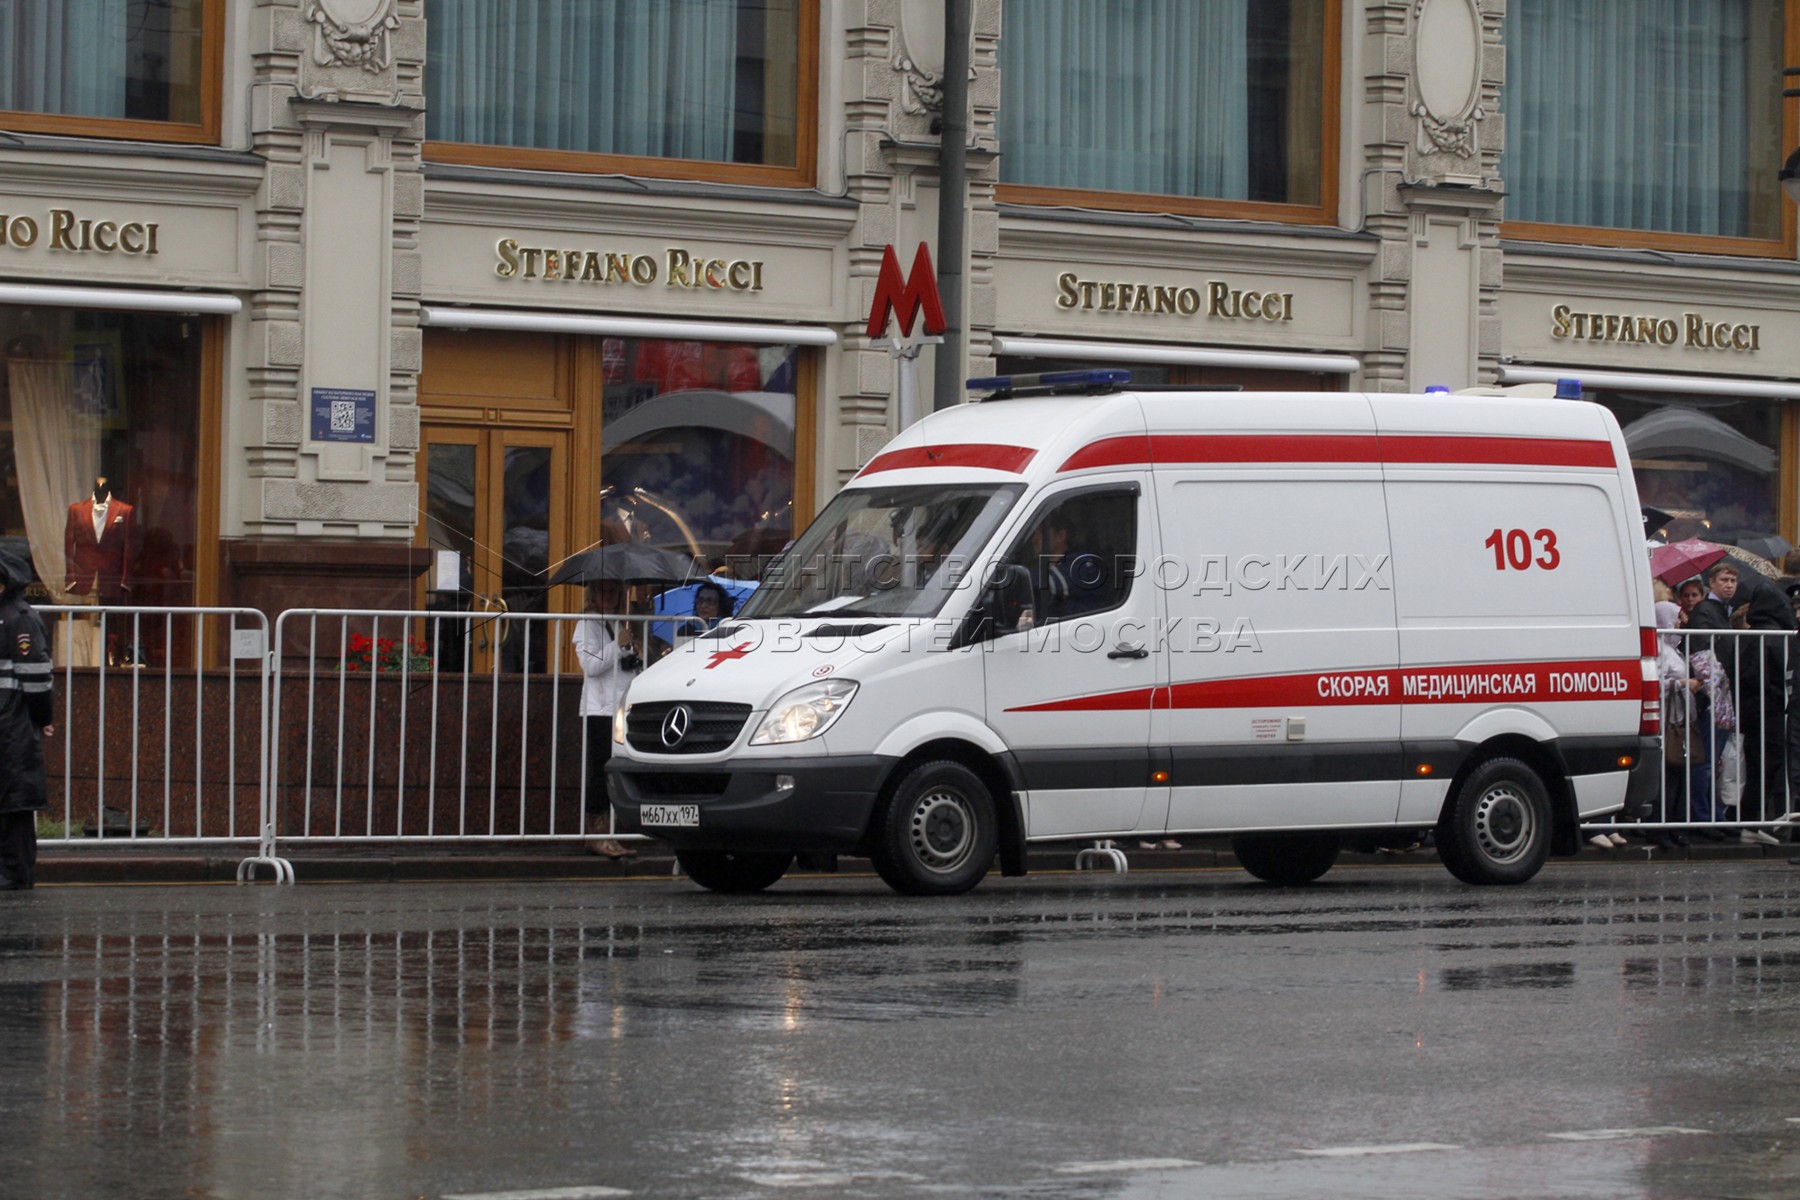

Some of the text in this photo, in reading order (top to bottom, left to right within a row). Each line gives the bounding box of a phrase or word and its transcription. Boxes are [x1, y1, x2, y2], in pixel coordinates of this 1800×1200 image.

[1484, 528, 1560, 571] 103
[1317, 671, 1629, 700] СКОРАЯ МЕДИЦИНСКАЯ ПОМОЩЬ
[680, 806, 696, 819] 197
